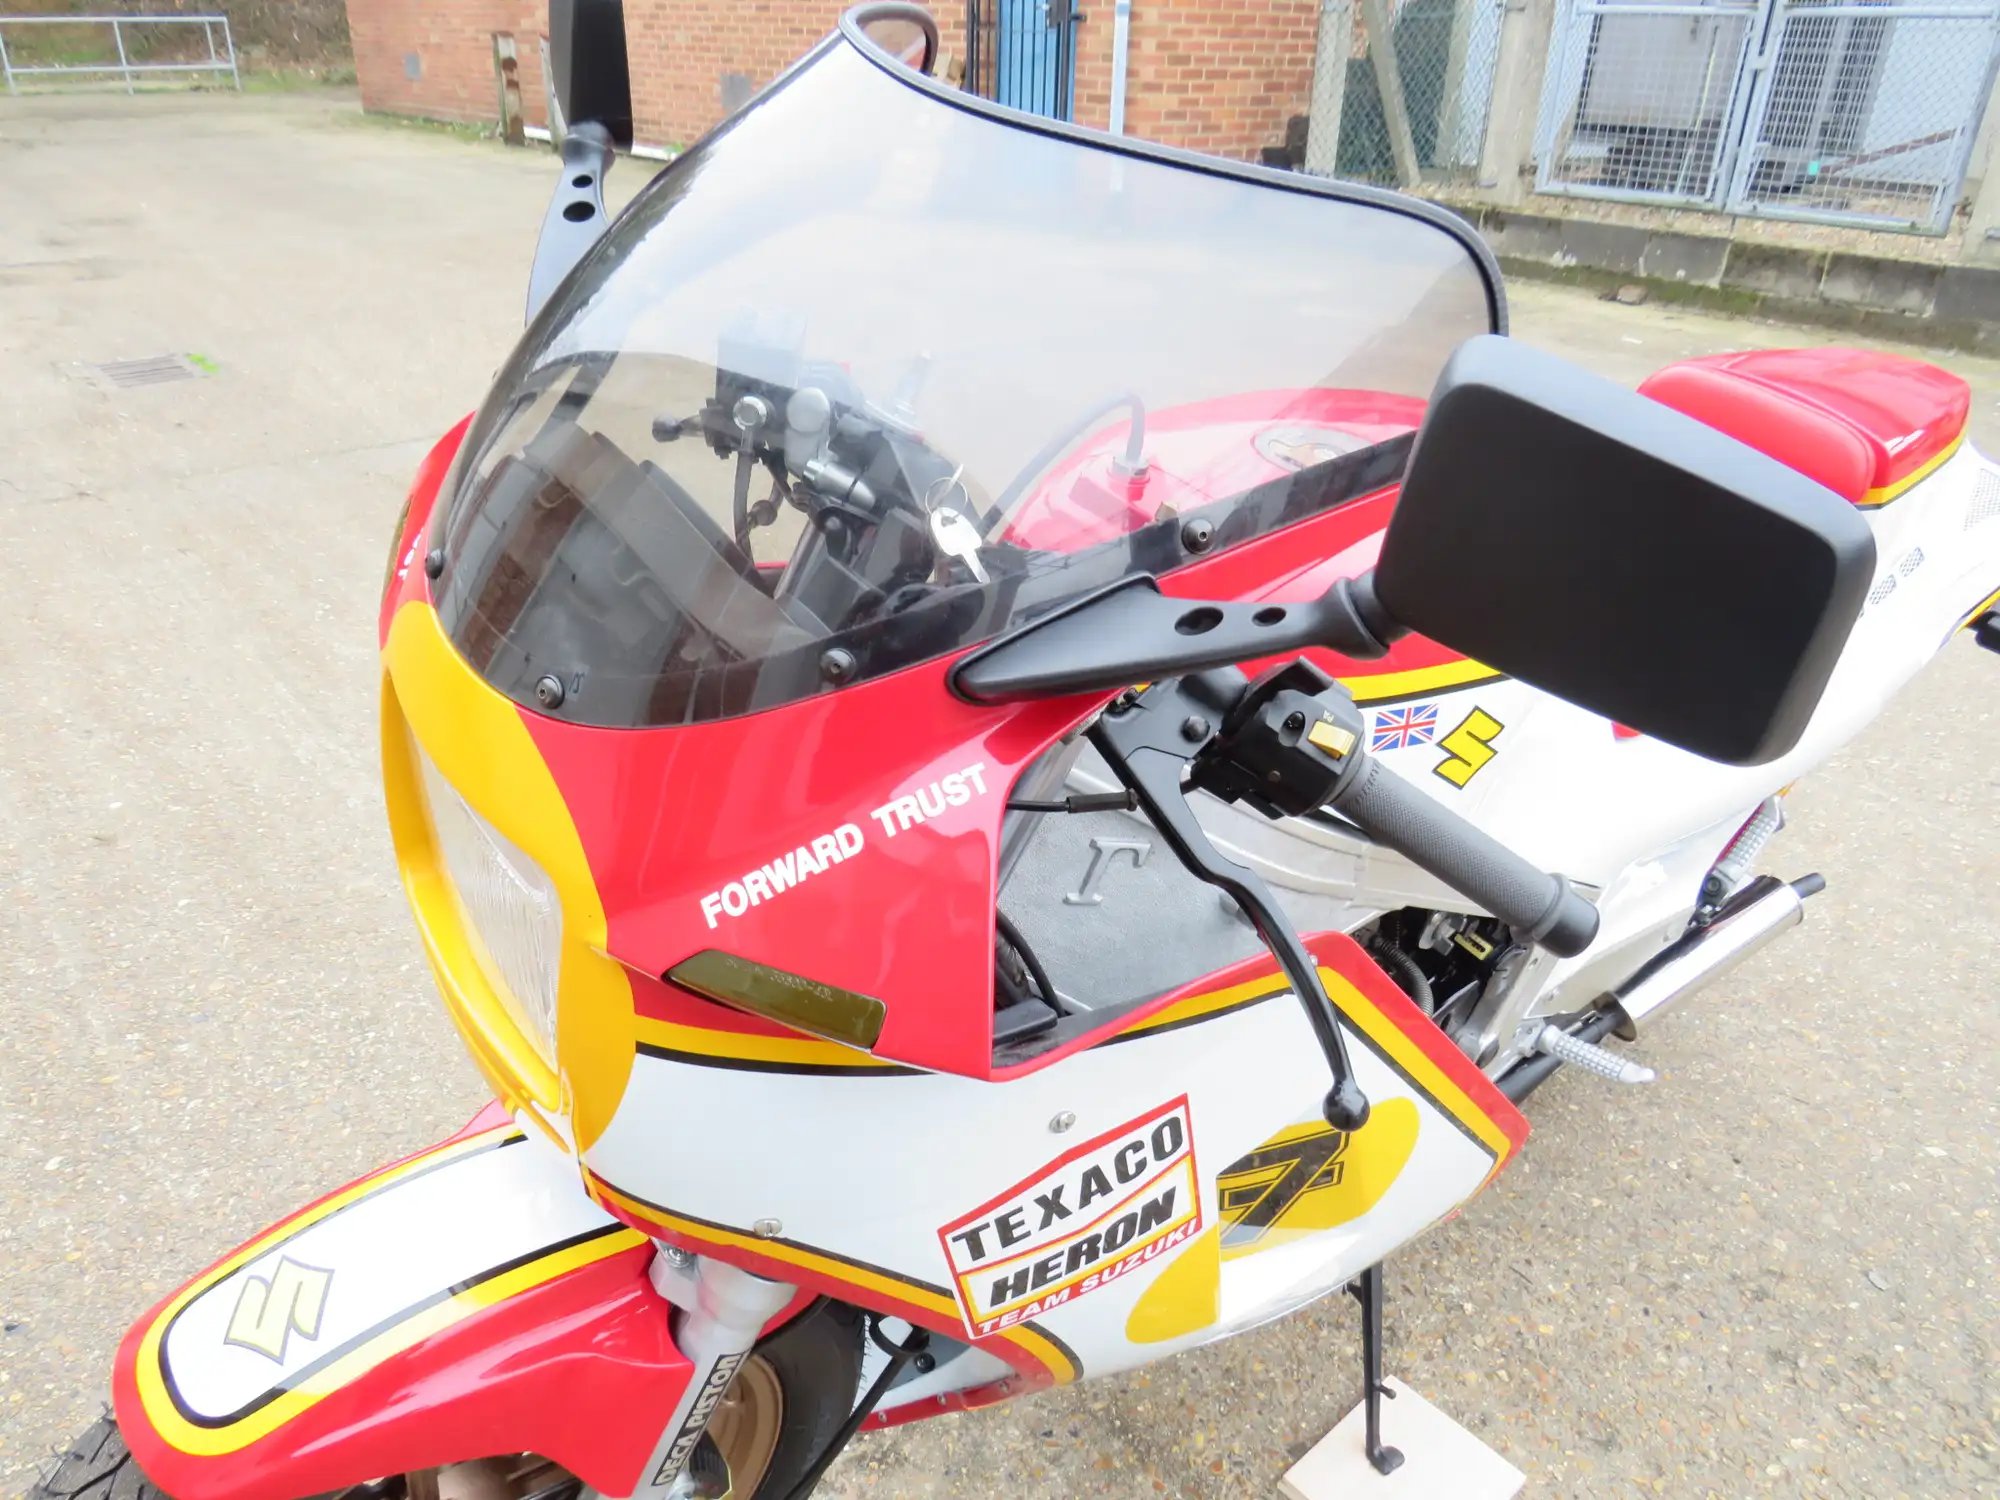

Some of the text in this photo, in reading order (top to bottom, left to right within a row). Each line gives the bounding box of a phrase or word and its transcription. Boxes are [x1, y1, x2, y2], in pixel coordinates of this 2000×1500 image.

[699, 761, 989, 930] FORWARD TRUST
[951, 1115, 1184, 1263] TEXACO
[989, 1184, 1177, 1309] HERON
[977, 1216, 1199, 1334] TEAM SUZUKI
[653, 1428, 701, 1485] DECA
